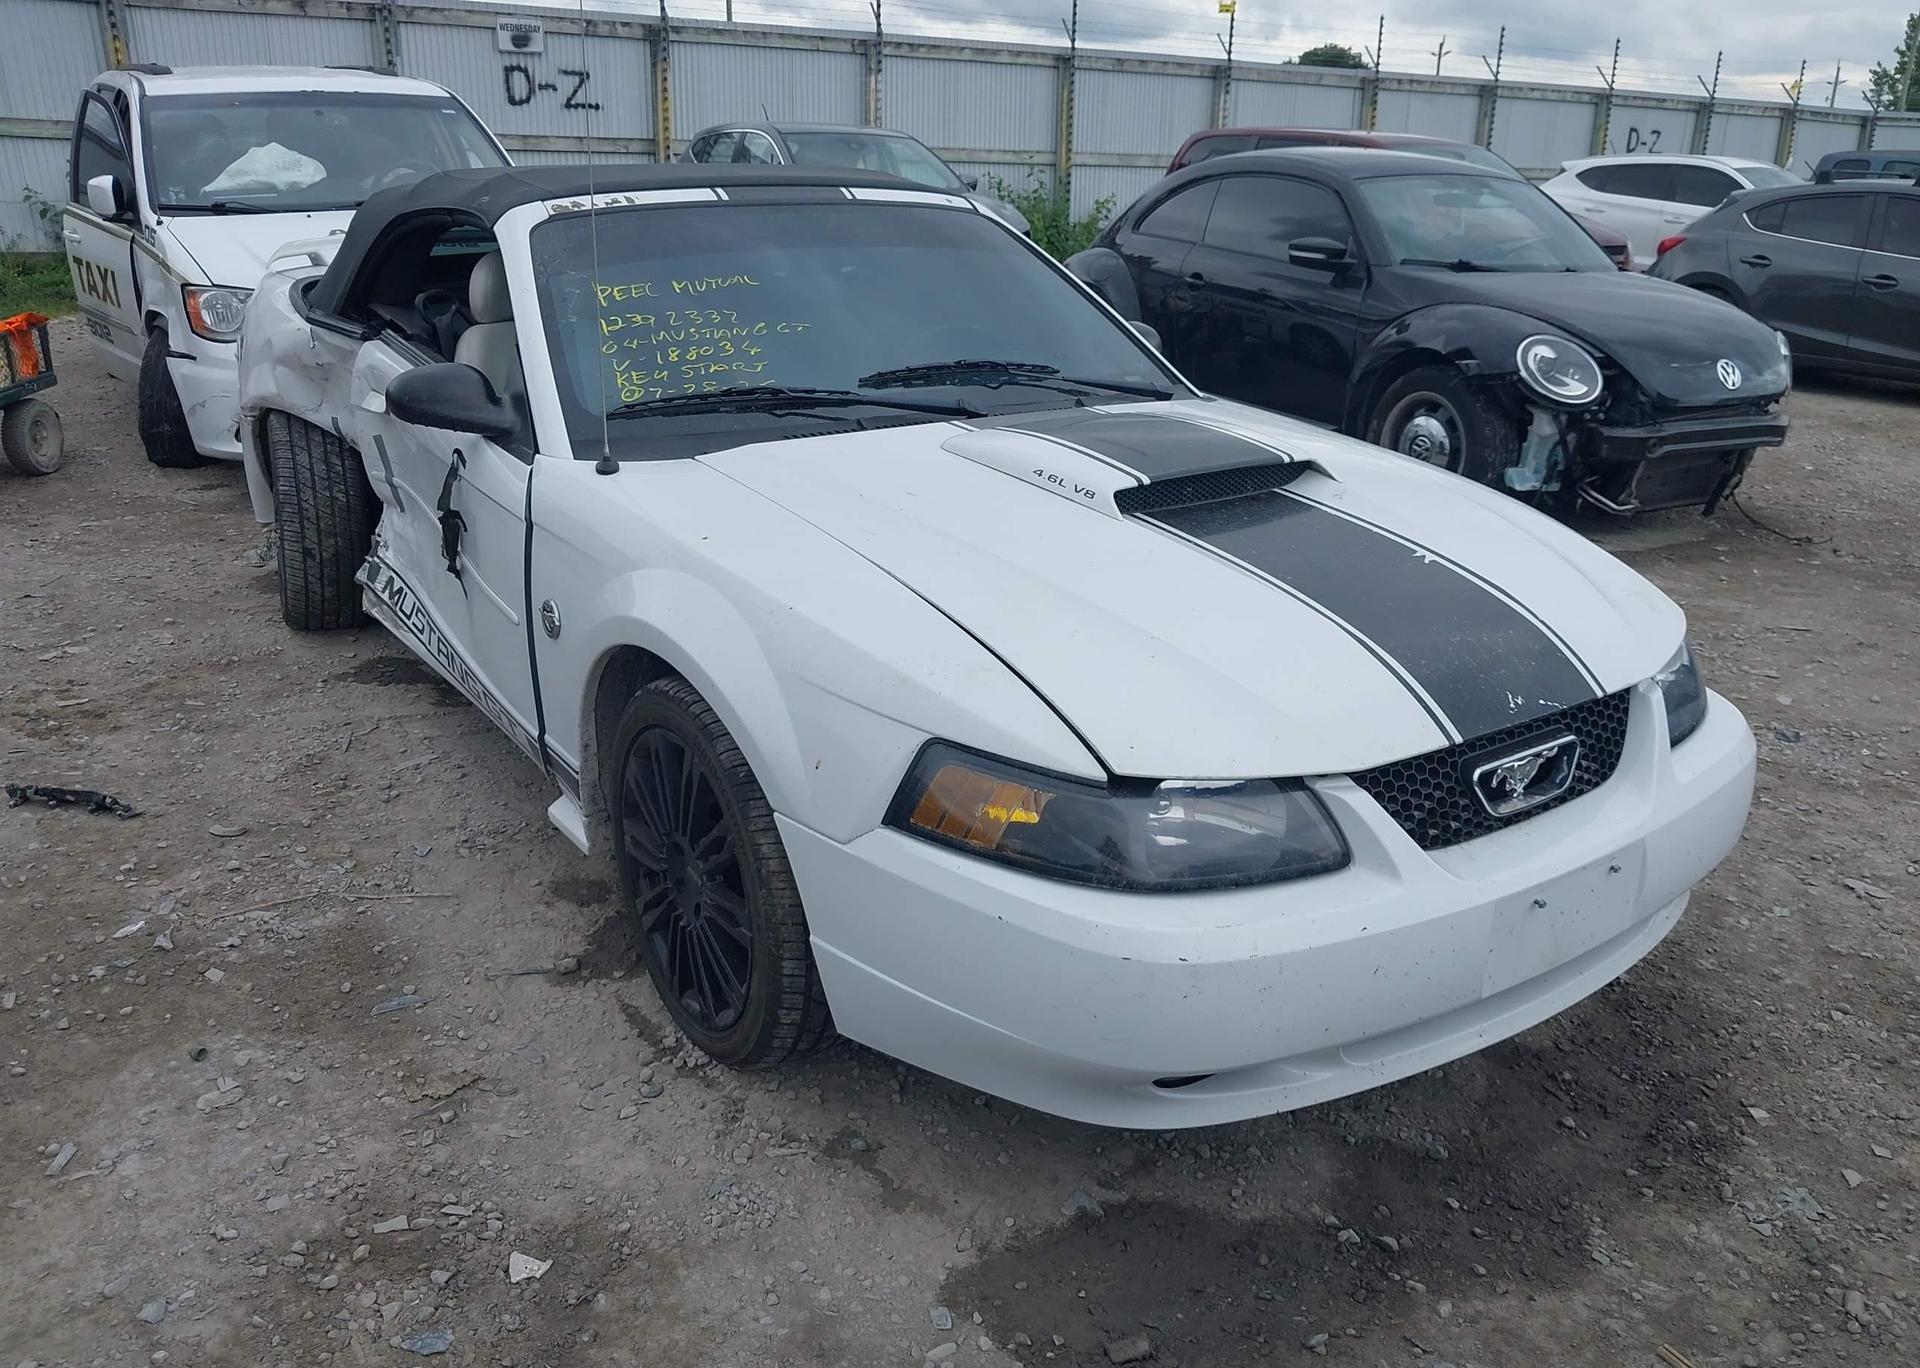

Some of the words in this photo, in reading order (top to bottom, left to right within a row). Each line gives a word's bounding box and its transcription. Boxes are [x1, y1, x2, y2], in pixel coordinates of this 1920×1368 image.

[499, 23, 541, 34] WEDNESDAY
[72, 255, 121, 309] TAXI
[1032, 468, 1067, 489] 4.6L
[1073, 483, 1096, 500] V8
[380, 574, 482, 703] MUSTANG
